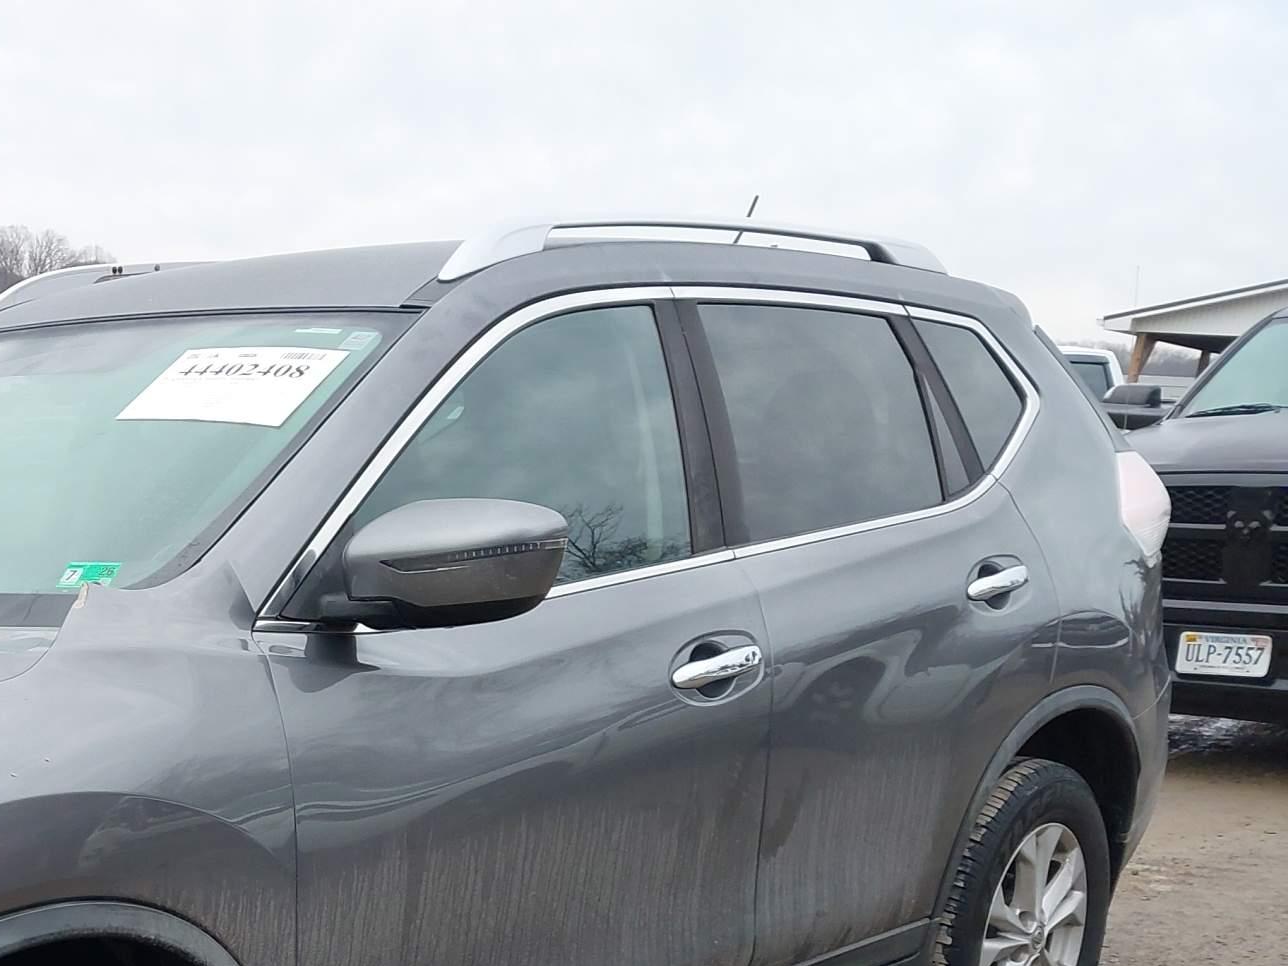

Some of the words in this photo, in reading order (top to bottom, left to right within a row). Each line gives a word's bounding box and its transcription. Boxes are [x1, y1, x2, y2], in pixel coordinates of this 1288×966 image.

[179, 364, 310, 378] 44402408
[99, 567, 115, 576] 26
[1204, 635, 1248, 644] VIRGINIA
[1185, 644, 1265, 665] ULP-7557
